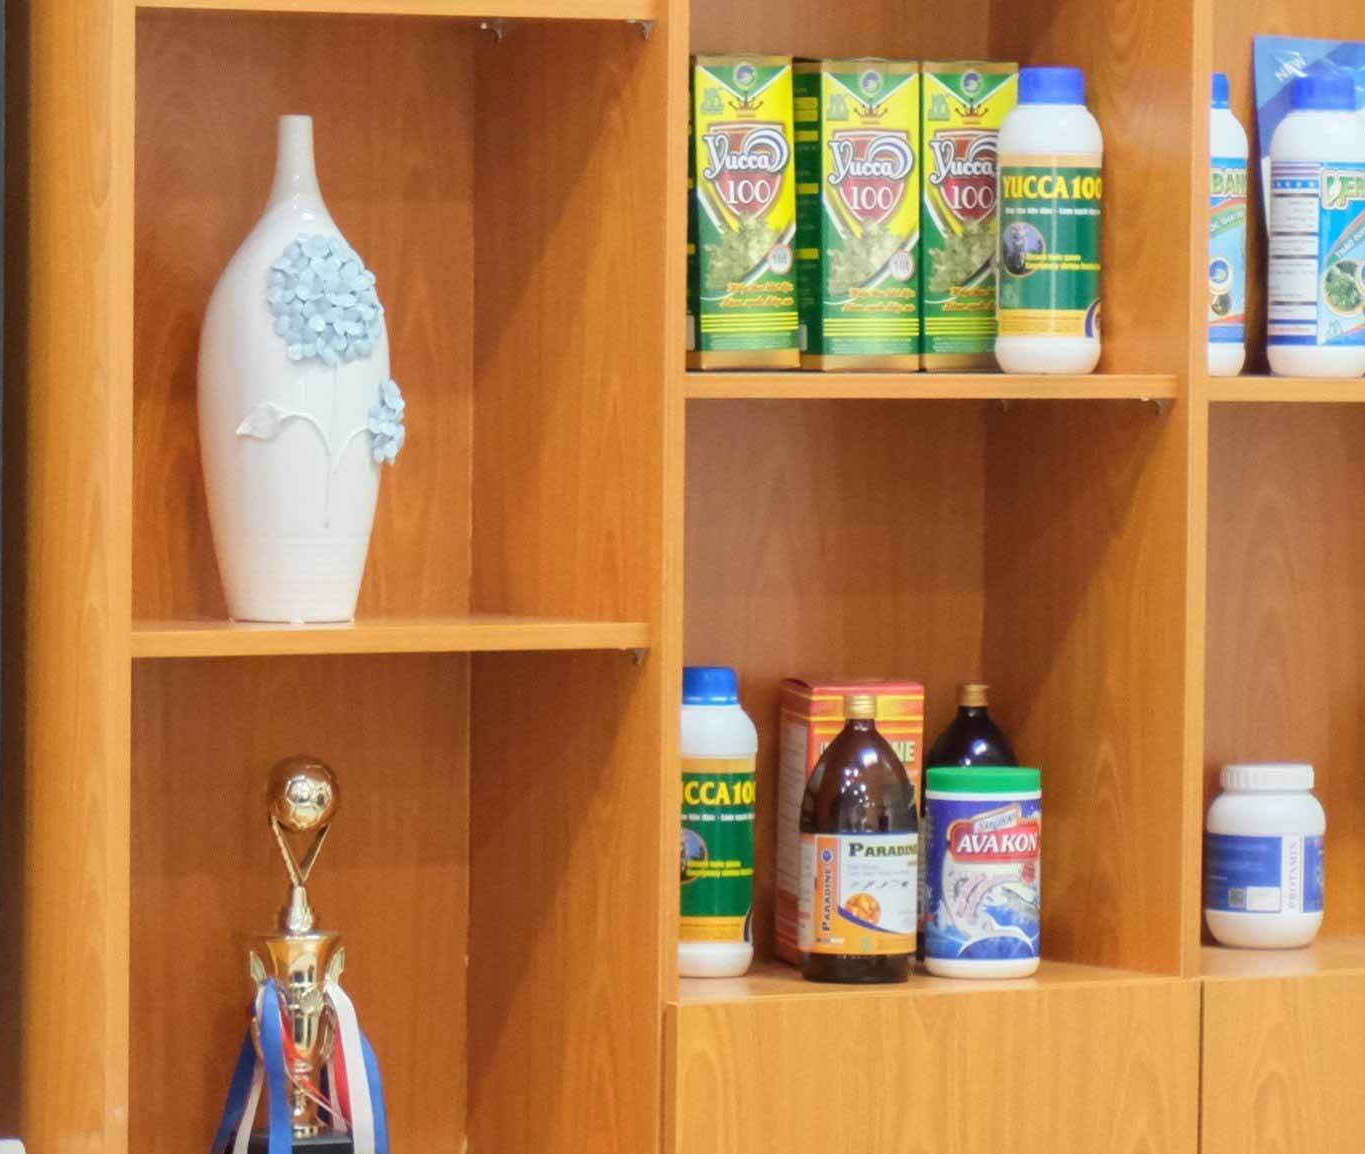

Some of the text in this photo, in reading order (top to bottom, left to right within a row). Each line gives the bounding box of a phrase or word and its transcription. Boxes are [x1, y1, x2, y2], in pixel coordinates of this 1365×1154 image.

[704, 131, 781, 179] Yucca
[828, 138, 905, 184] Yucca
[930, 138, 997, 184] Yucca
[726, 179, 772, 204] 100
[850, 185, 893, 209] 100
[952, 185, 996, 209] 100
[1002, 175, 1069, 200] YUCCA
[682, 781, 732, 806] CCA
[957, 834, 1037, 853] AVAKON
